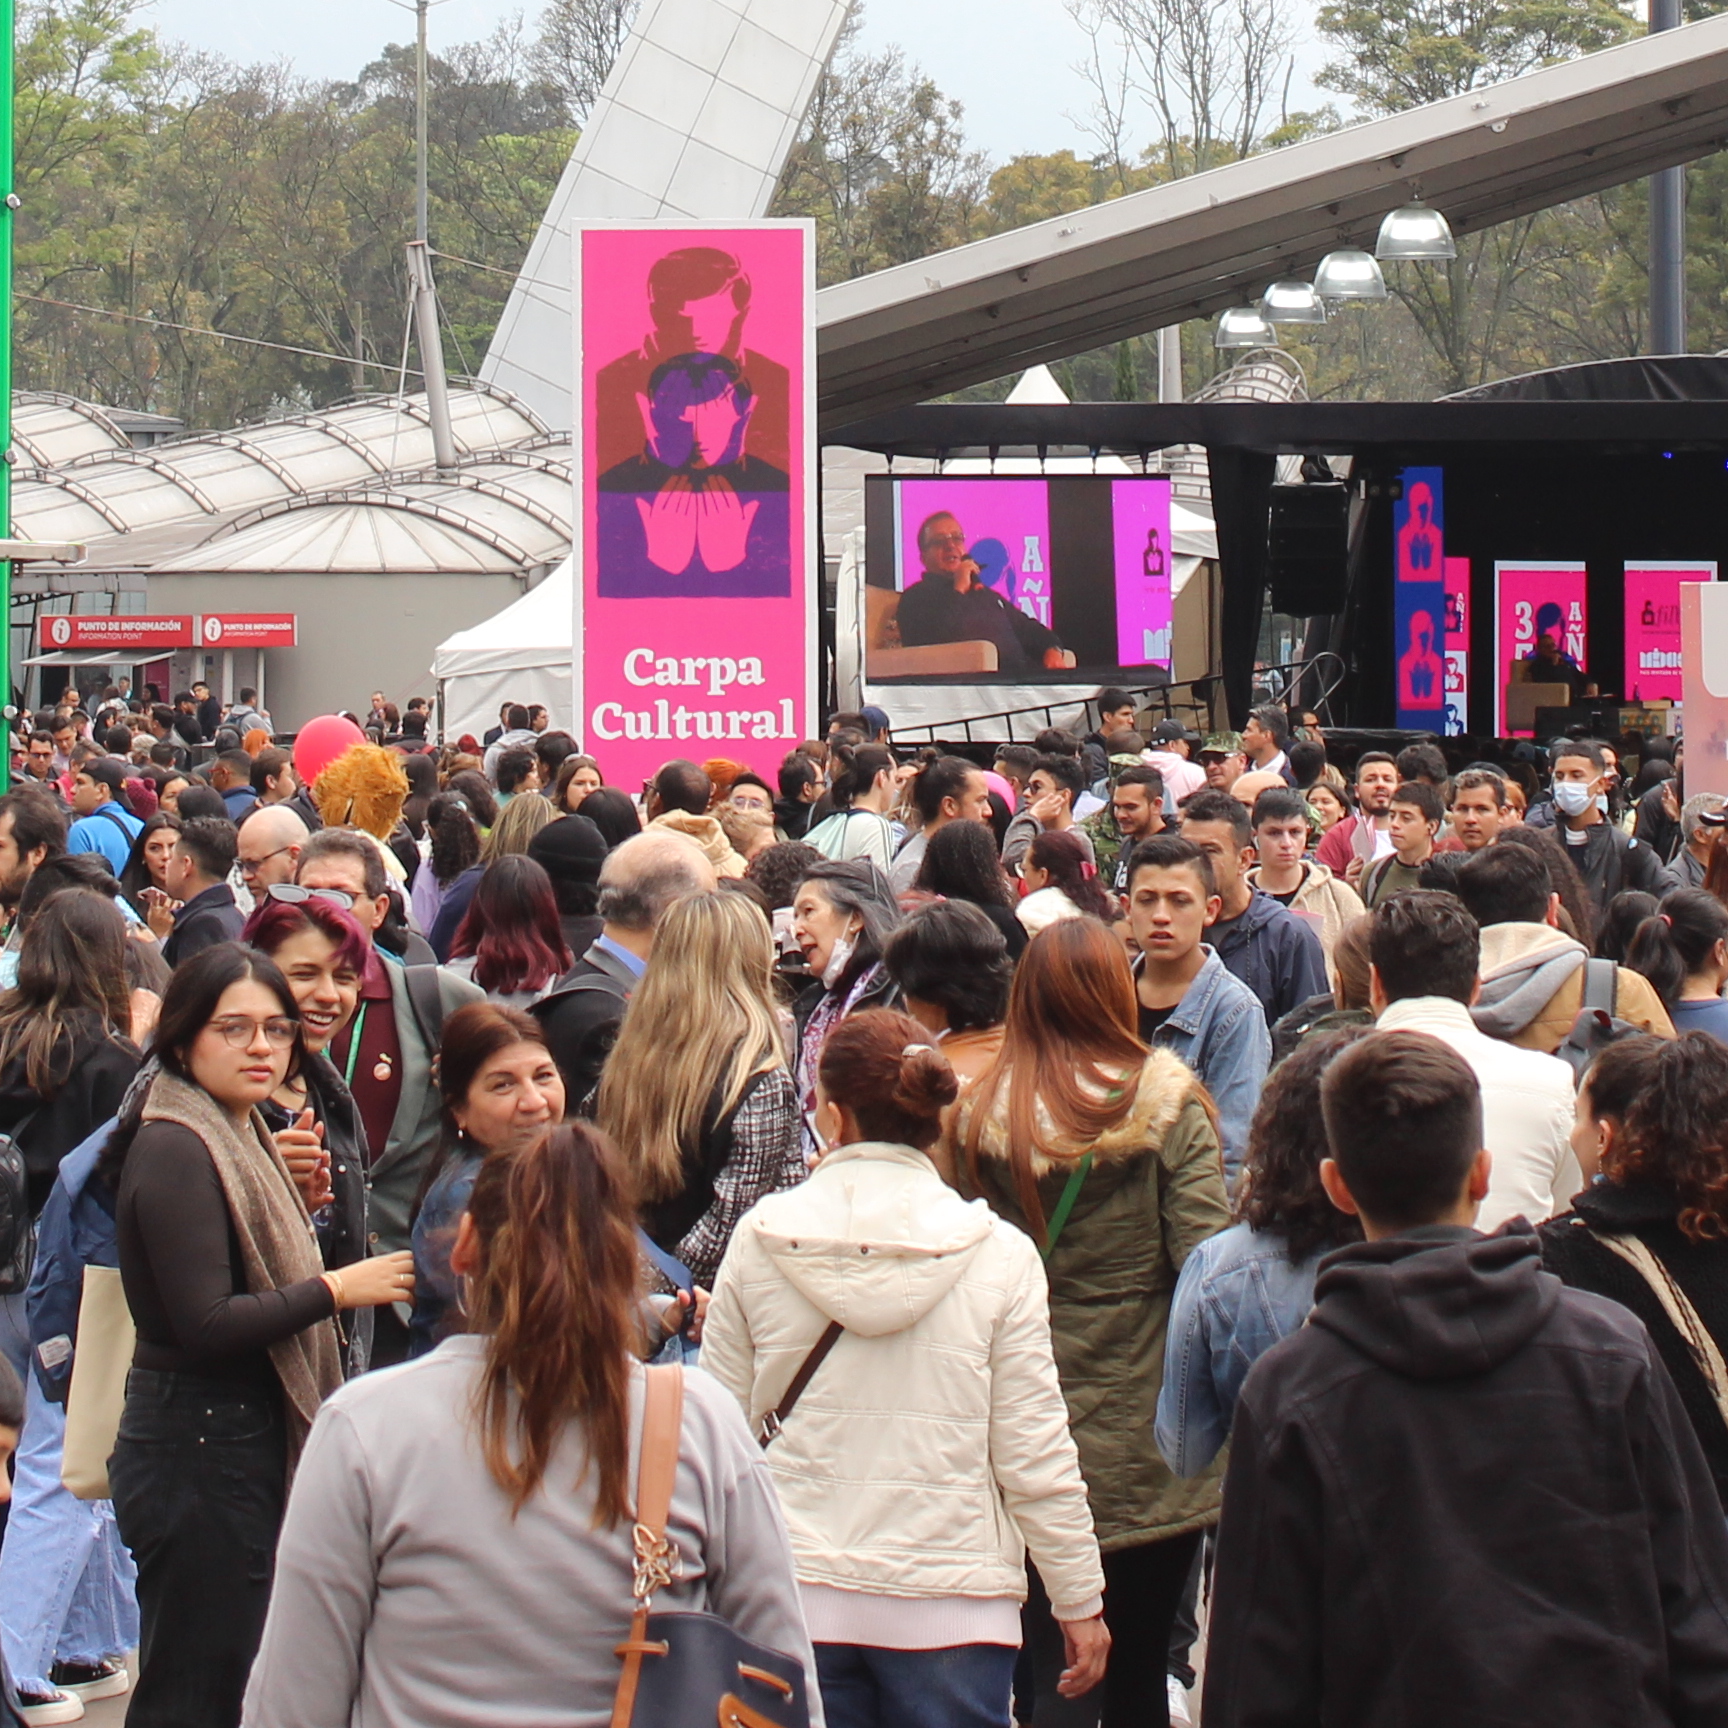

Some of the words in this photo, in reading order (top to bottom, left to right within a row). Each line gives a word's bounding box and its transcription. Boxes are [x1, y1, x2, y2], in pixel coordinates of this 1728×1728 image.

[77, 621, 107, 631] PUNTO
[108, 621, 120, 631] DE
[121, 619, 182, 631] INFORMACIÓN
[622, 647, 766, 696] Carpa
[591, 698, 797, 741] Cultural
